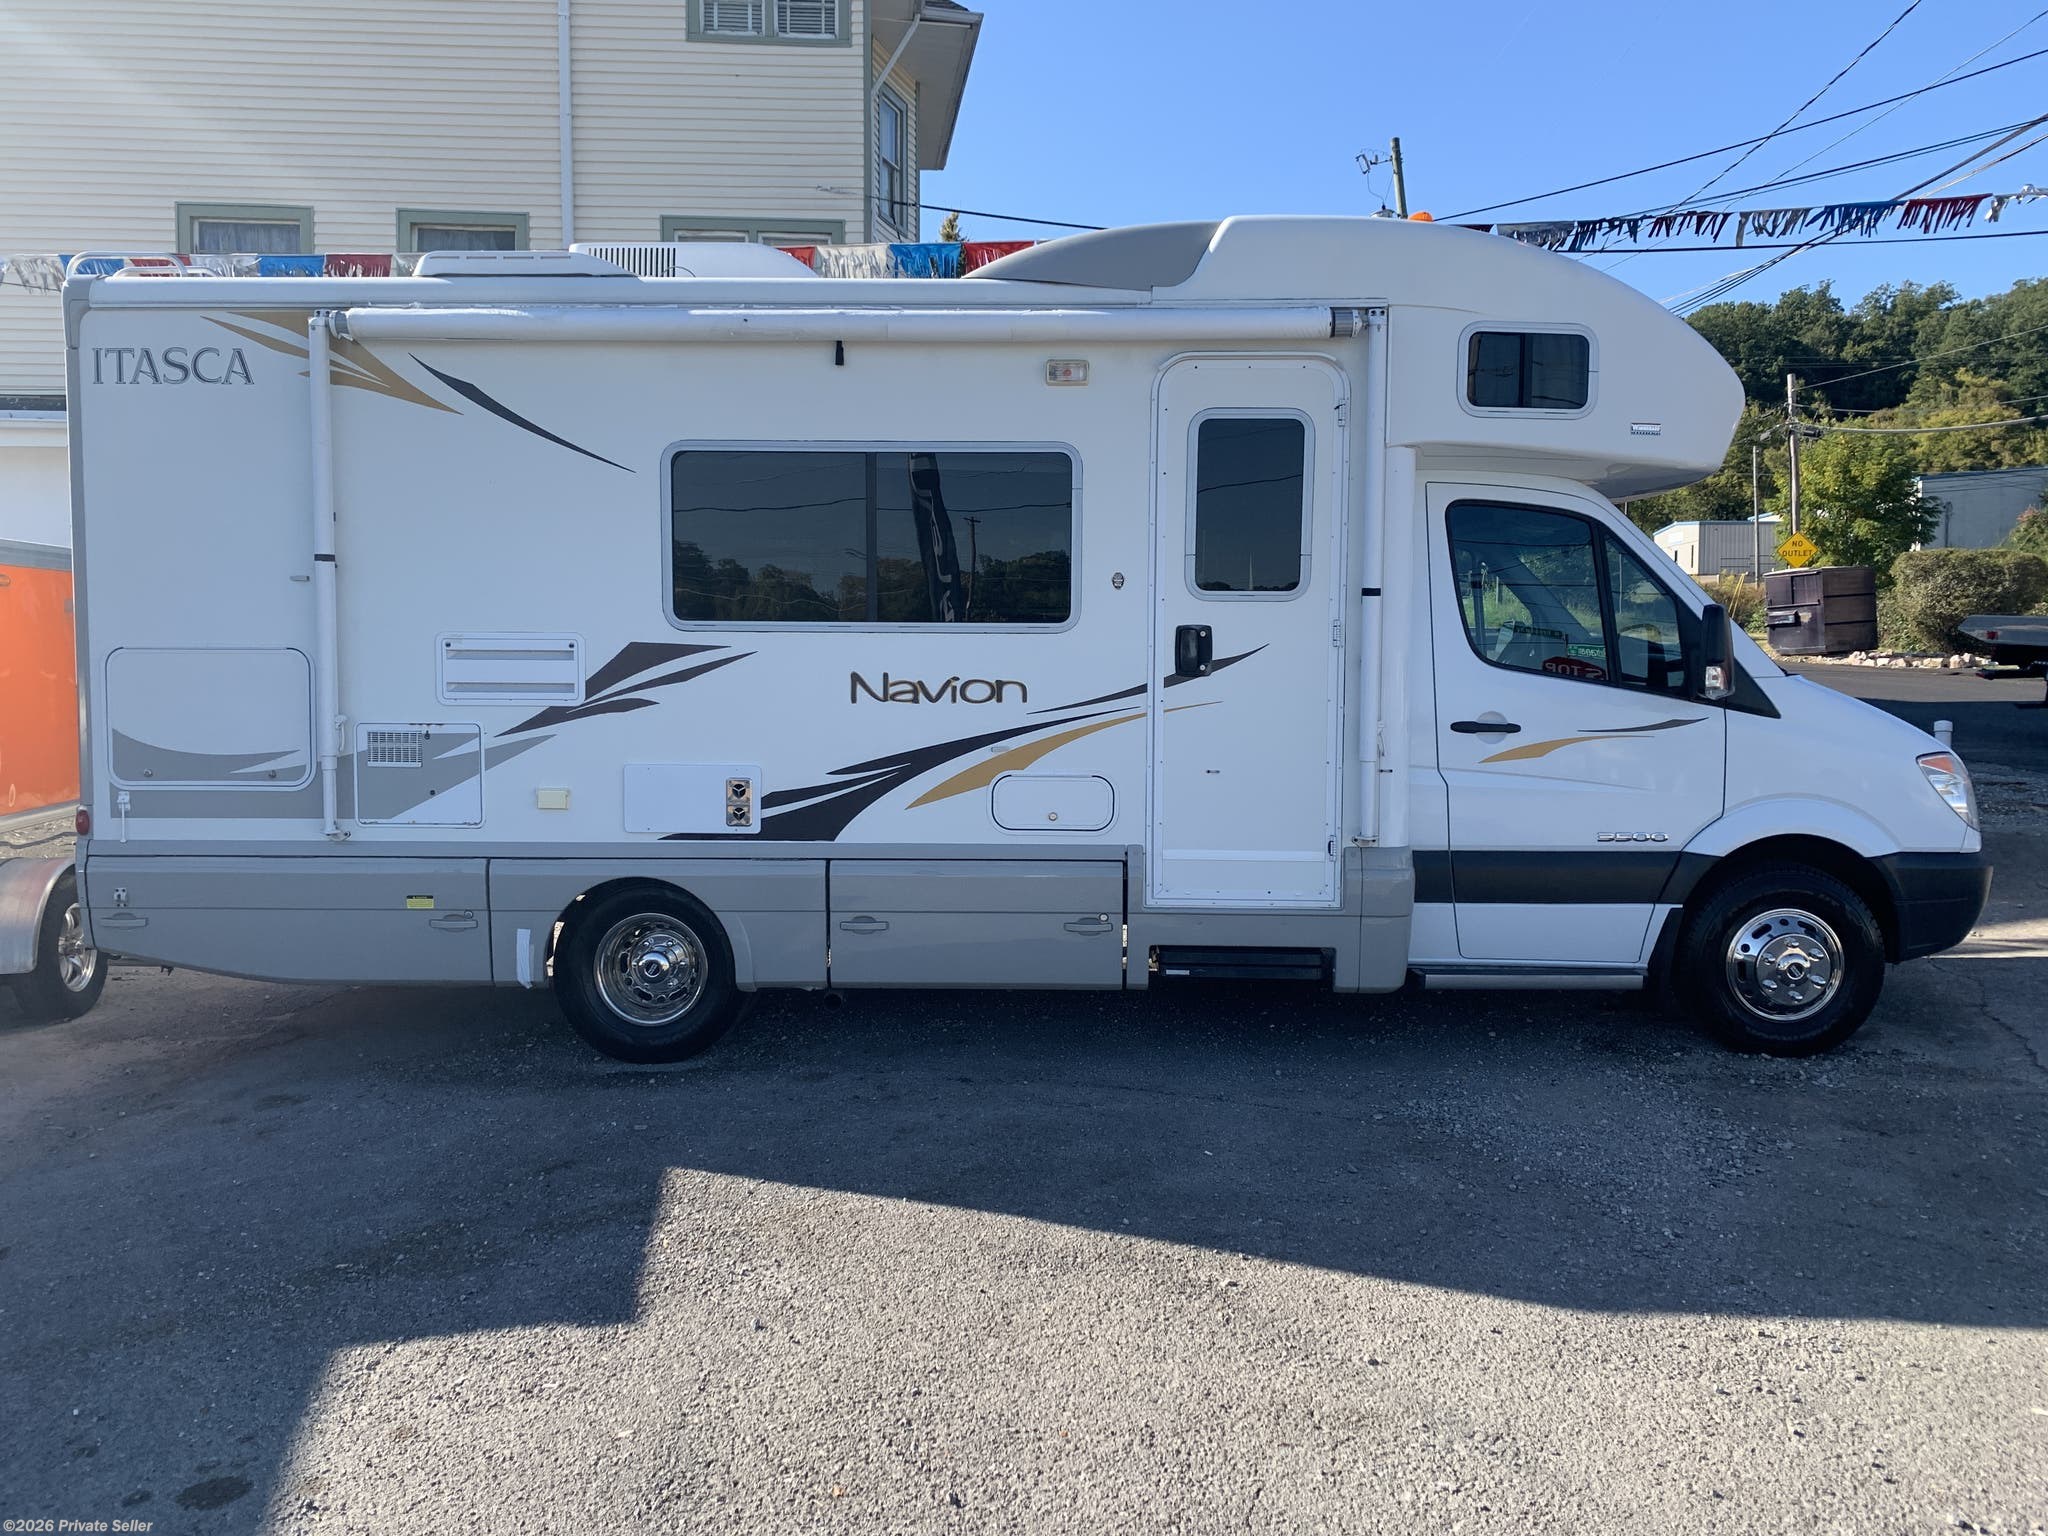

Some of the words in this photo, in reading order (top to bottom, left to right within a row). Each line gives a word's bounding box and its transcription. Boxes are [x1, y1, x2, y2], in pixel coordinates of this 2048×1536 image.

[92, 347, 255, 385] ITASCA
[1782, 549, 1812, 557] OUTLET
[850, 671, 1028, 704] Navion
[1597, 831, 1669, 843] 3500
